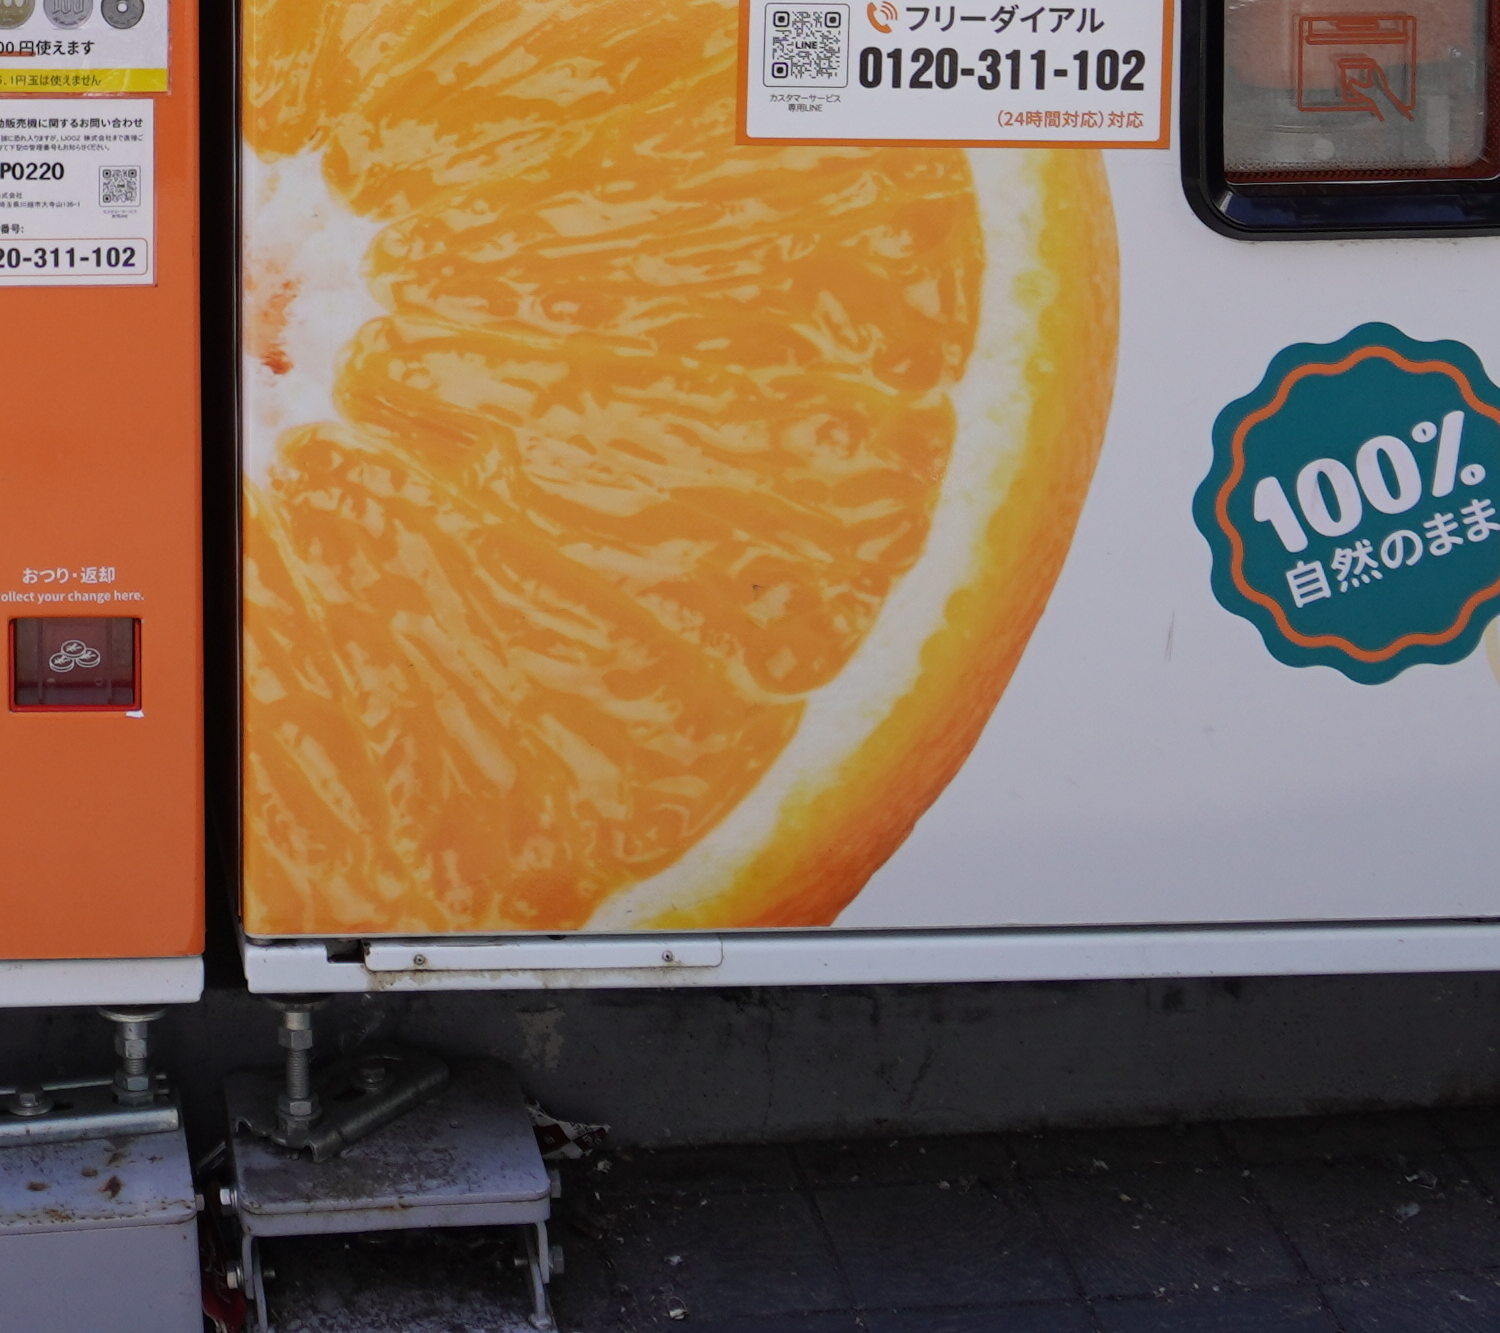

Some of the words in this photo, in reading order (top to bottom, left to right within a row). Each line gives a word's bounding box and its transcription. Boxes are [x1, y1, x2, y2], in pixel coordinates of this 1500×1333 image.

[905, 6, 1104, 34] フリーダイアル
[859, 47, 1144, 91] 0120-311-102
[1254, 410, 1486, 553] 100%
[22, 567, 116, 584] おつり・返却
[37, 592, 65, 604] your
[68, 591, 111, 603] change
[114, 591, 144, 601] here.
